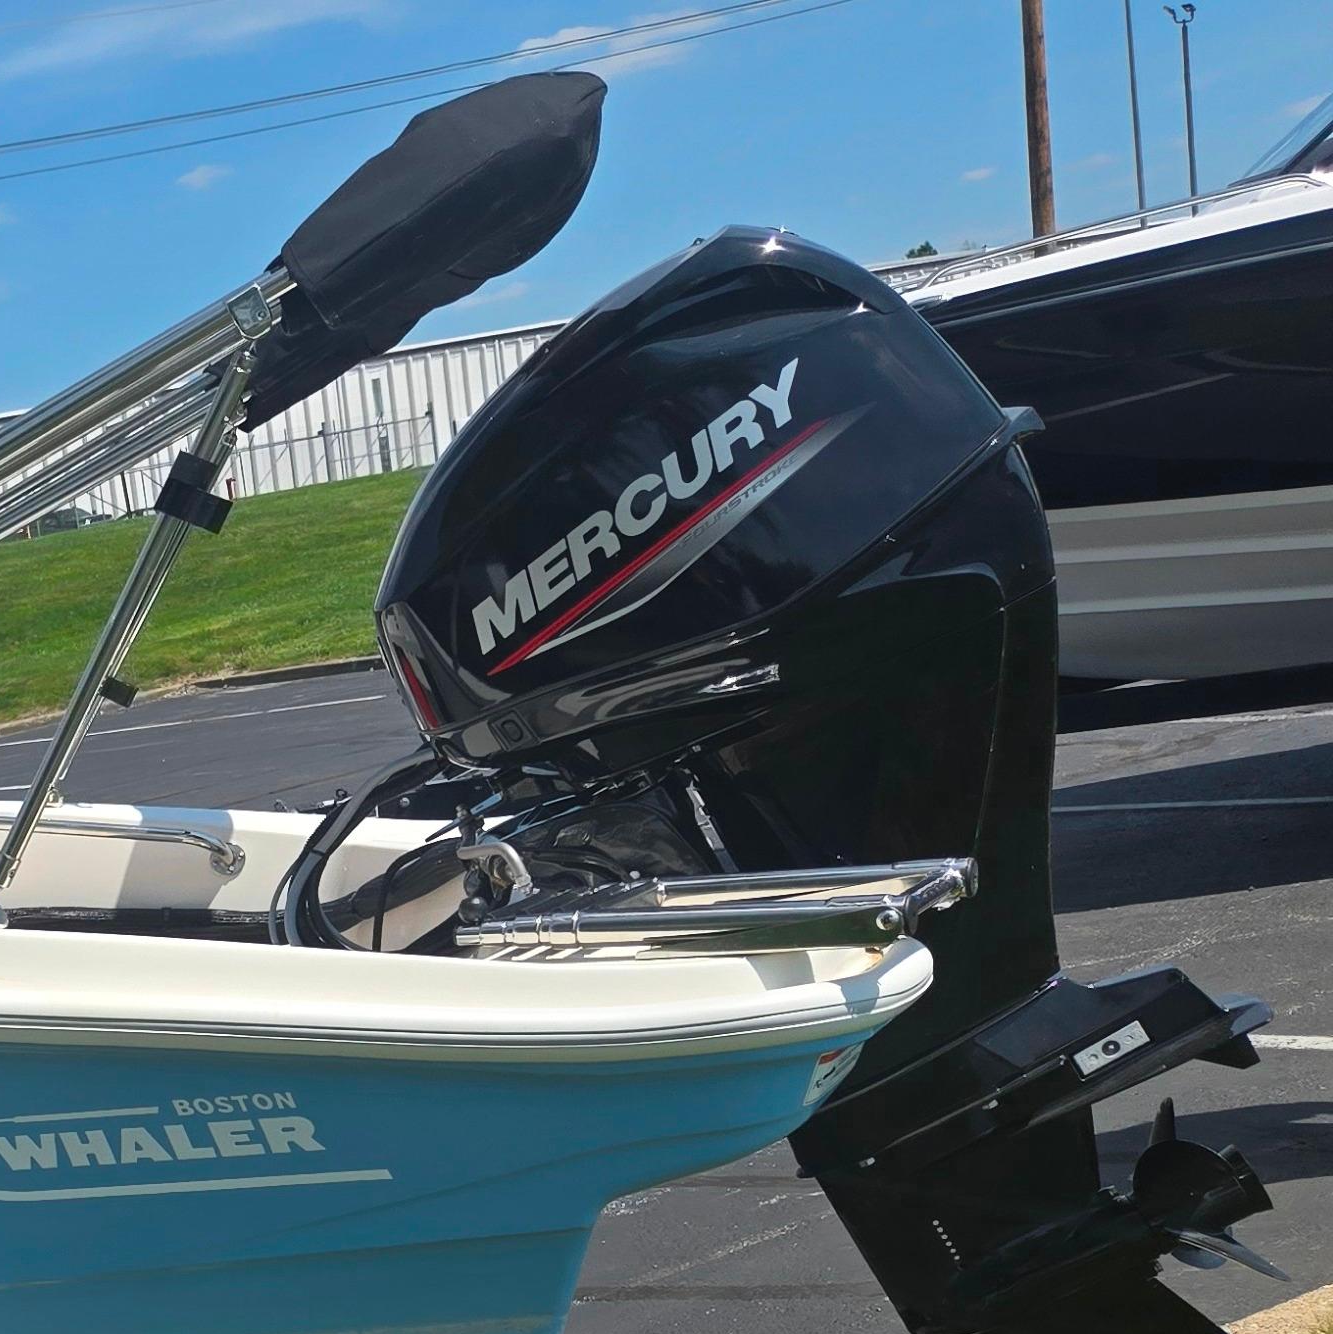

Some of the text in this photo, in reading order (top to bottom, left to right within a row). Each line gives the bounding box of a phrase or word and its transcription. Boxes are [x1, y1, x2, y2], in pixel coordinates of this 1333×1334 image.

[471, 357, 799, 656] MERCURY
[682, 453, 798, 544] FOURSTROKE
[172, 1091, 297, 1116] BOSTON
